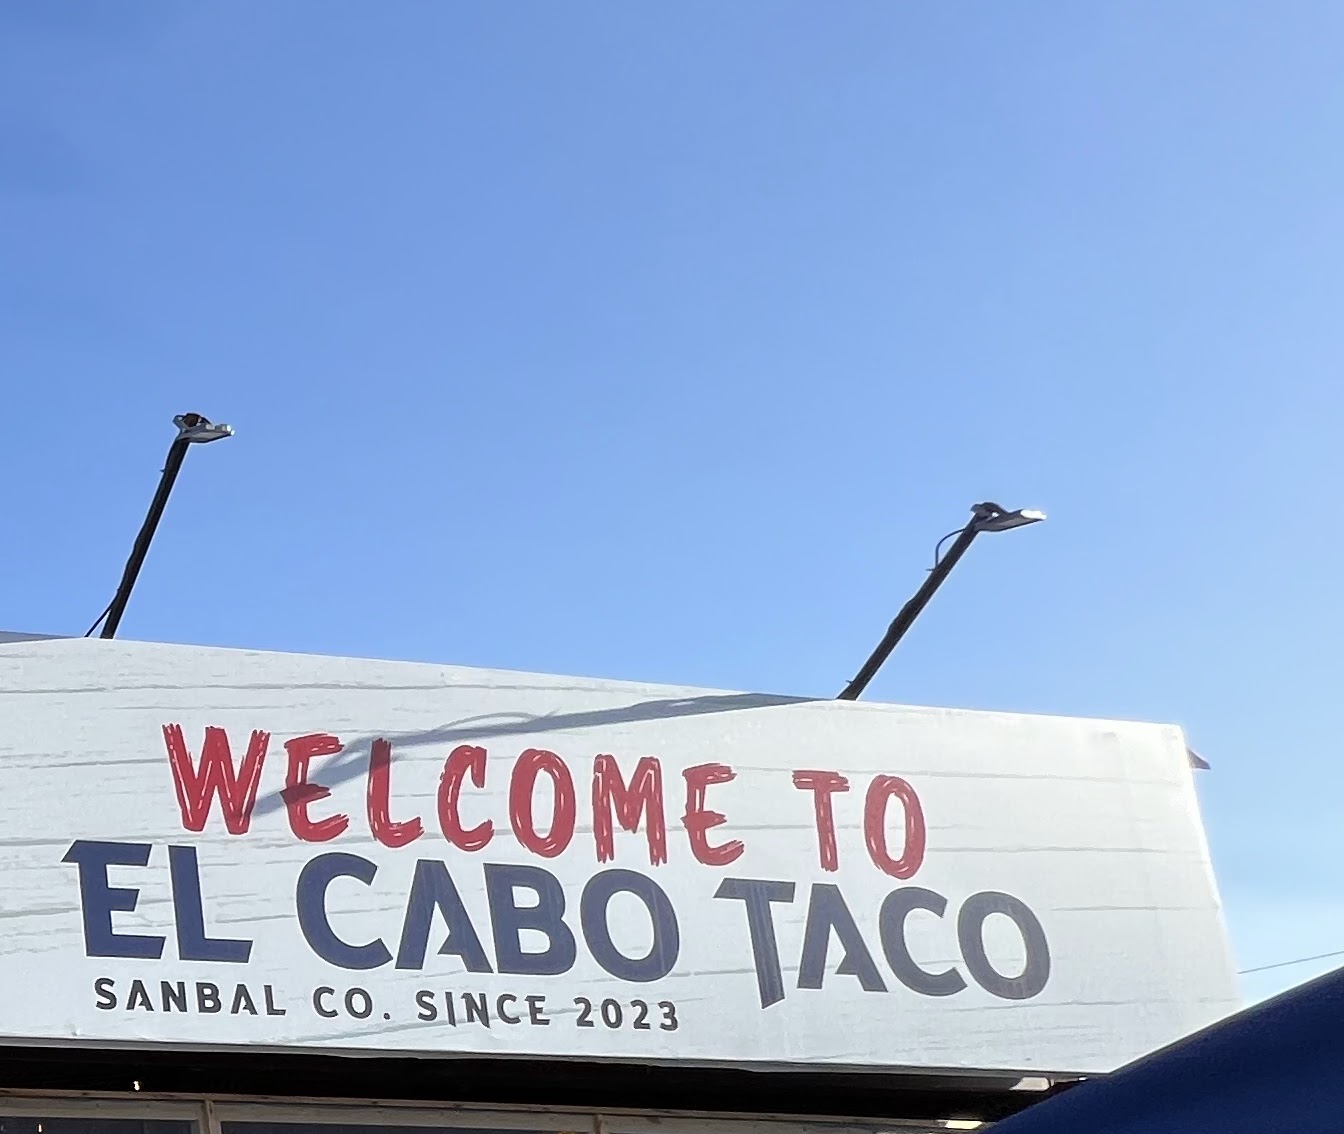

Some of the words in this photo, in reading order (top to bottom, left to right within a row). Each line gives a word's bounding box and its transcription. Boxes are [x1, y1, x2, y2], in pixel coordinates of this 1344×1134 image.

[162, 721, 745, 867] WELCOME
[792, 769, 927, 881] TO
[62, 839, 254, 964] EL
[295, 851, 680, 983] CABO
[712, 877, 1052, 1010] TACO
[94, 977, 287, 1017] SANBAL
[312, 986, 393, 1020] CO.
[417, 990, 551, 1029] SINCE
[575, 996, 680, 1032] 2023
